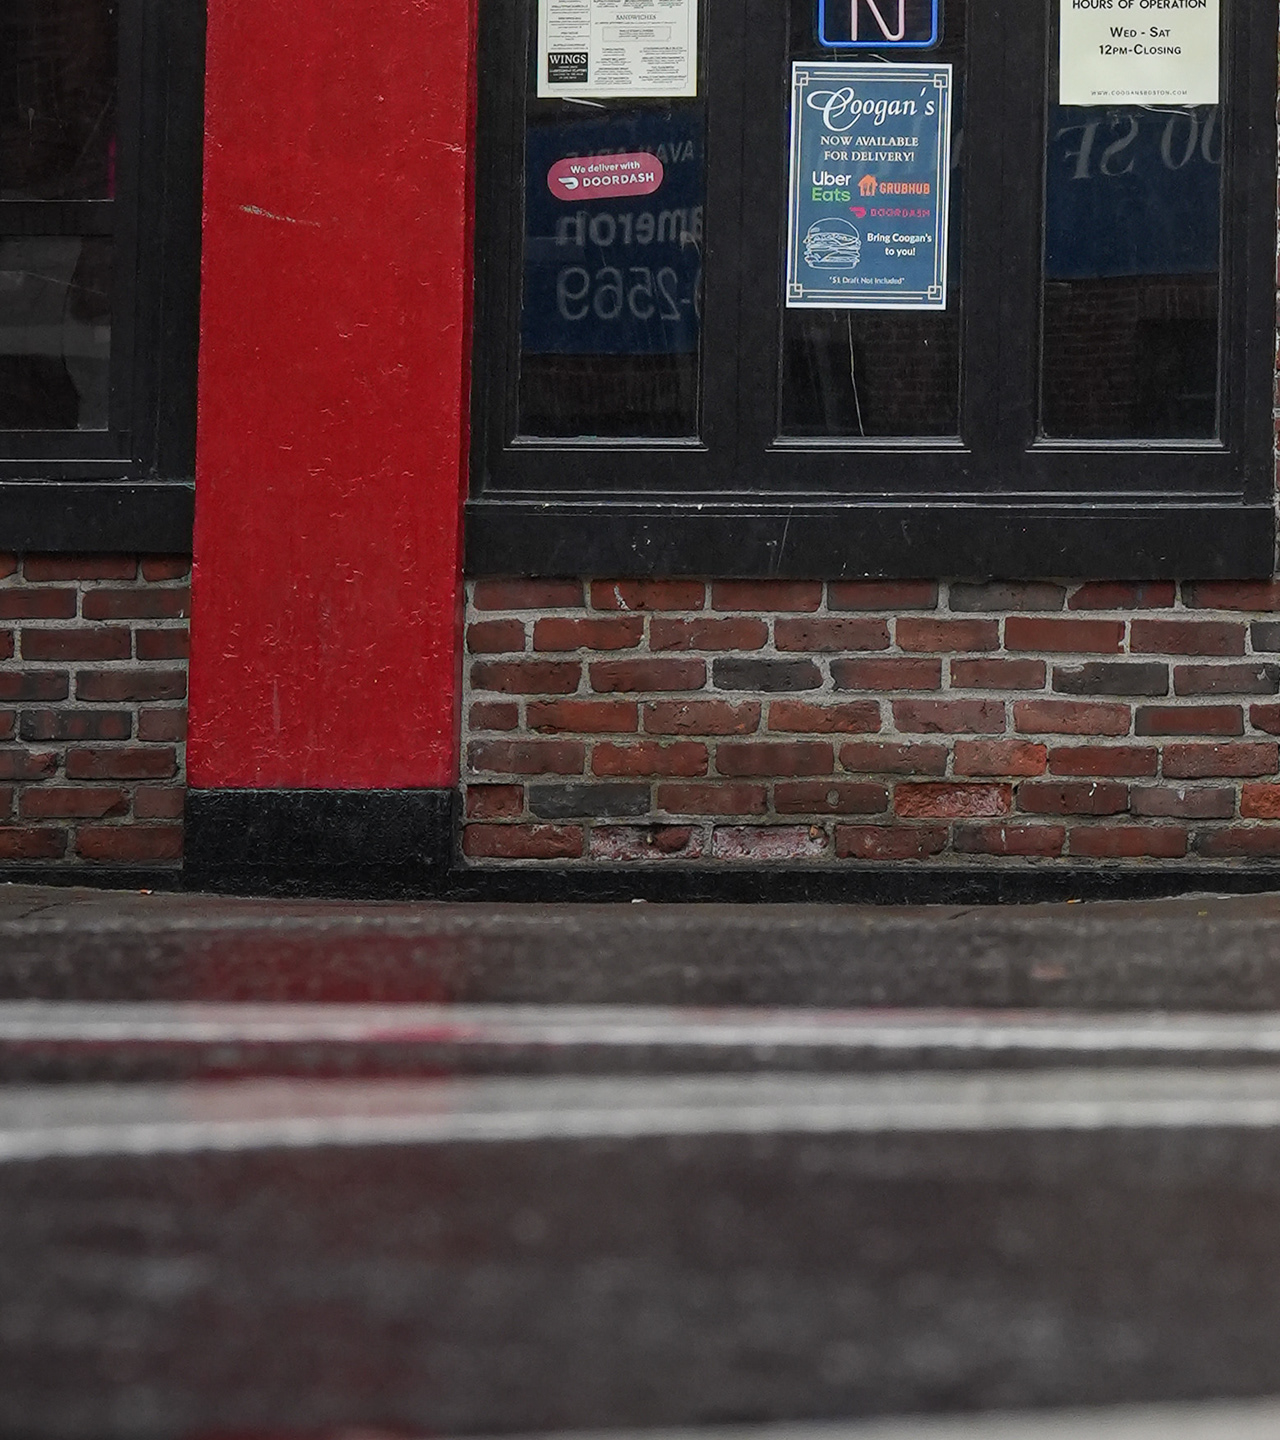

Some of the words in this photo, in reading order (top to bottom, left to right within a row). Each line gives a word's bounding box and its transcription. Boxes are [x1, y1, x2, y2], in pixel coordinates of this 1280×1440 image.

[1072, 0, 1113, 9] HOURS
[1118, 0, 1134, 8] OF
[549, 54, 587, 64] WINGS
[806, 86, 935, 132] Coogan's
[820, 136, 852, 146] NOW
[855, 136, 920, 147] AVAILABLE
[824, 151, 848, 160] FOR
[851, 152, 915, 162] DELIVERY!
[570, 166, 586, 174] We
[587, 163, 618, 174] deliver
[619, 160, 640, 170] with
[582, 172, 654, 188] DOORDASH
[812, 171, 852, 186] Uber
[879, 182, 930, 194] GRUBHUB
[812, 187, 850, 202] Eats
[870, 208, 930, 218] DOORDASH
[867, 233, 890, 244] Bring
[892, 234, 932, 244] Coogan's
[884, 248, 895, 256] to
[896, 248, 916, 257] you!
